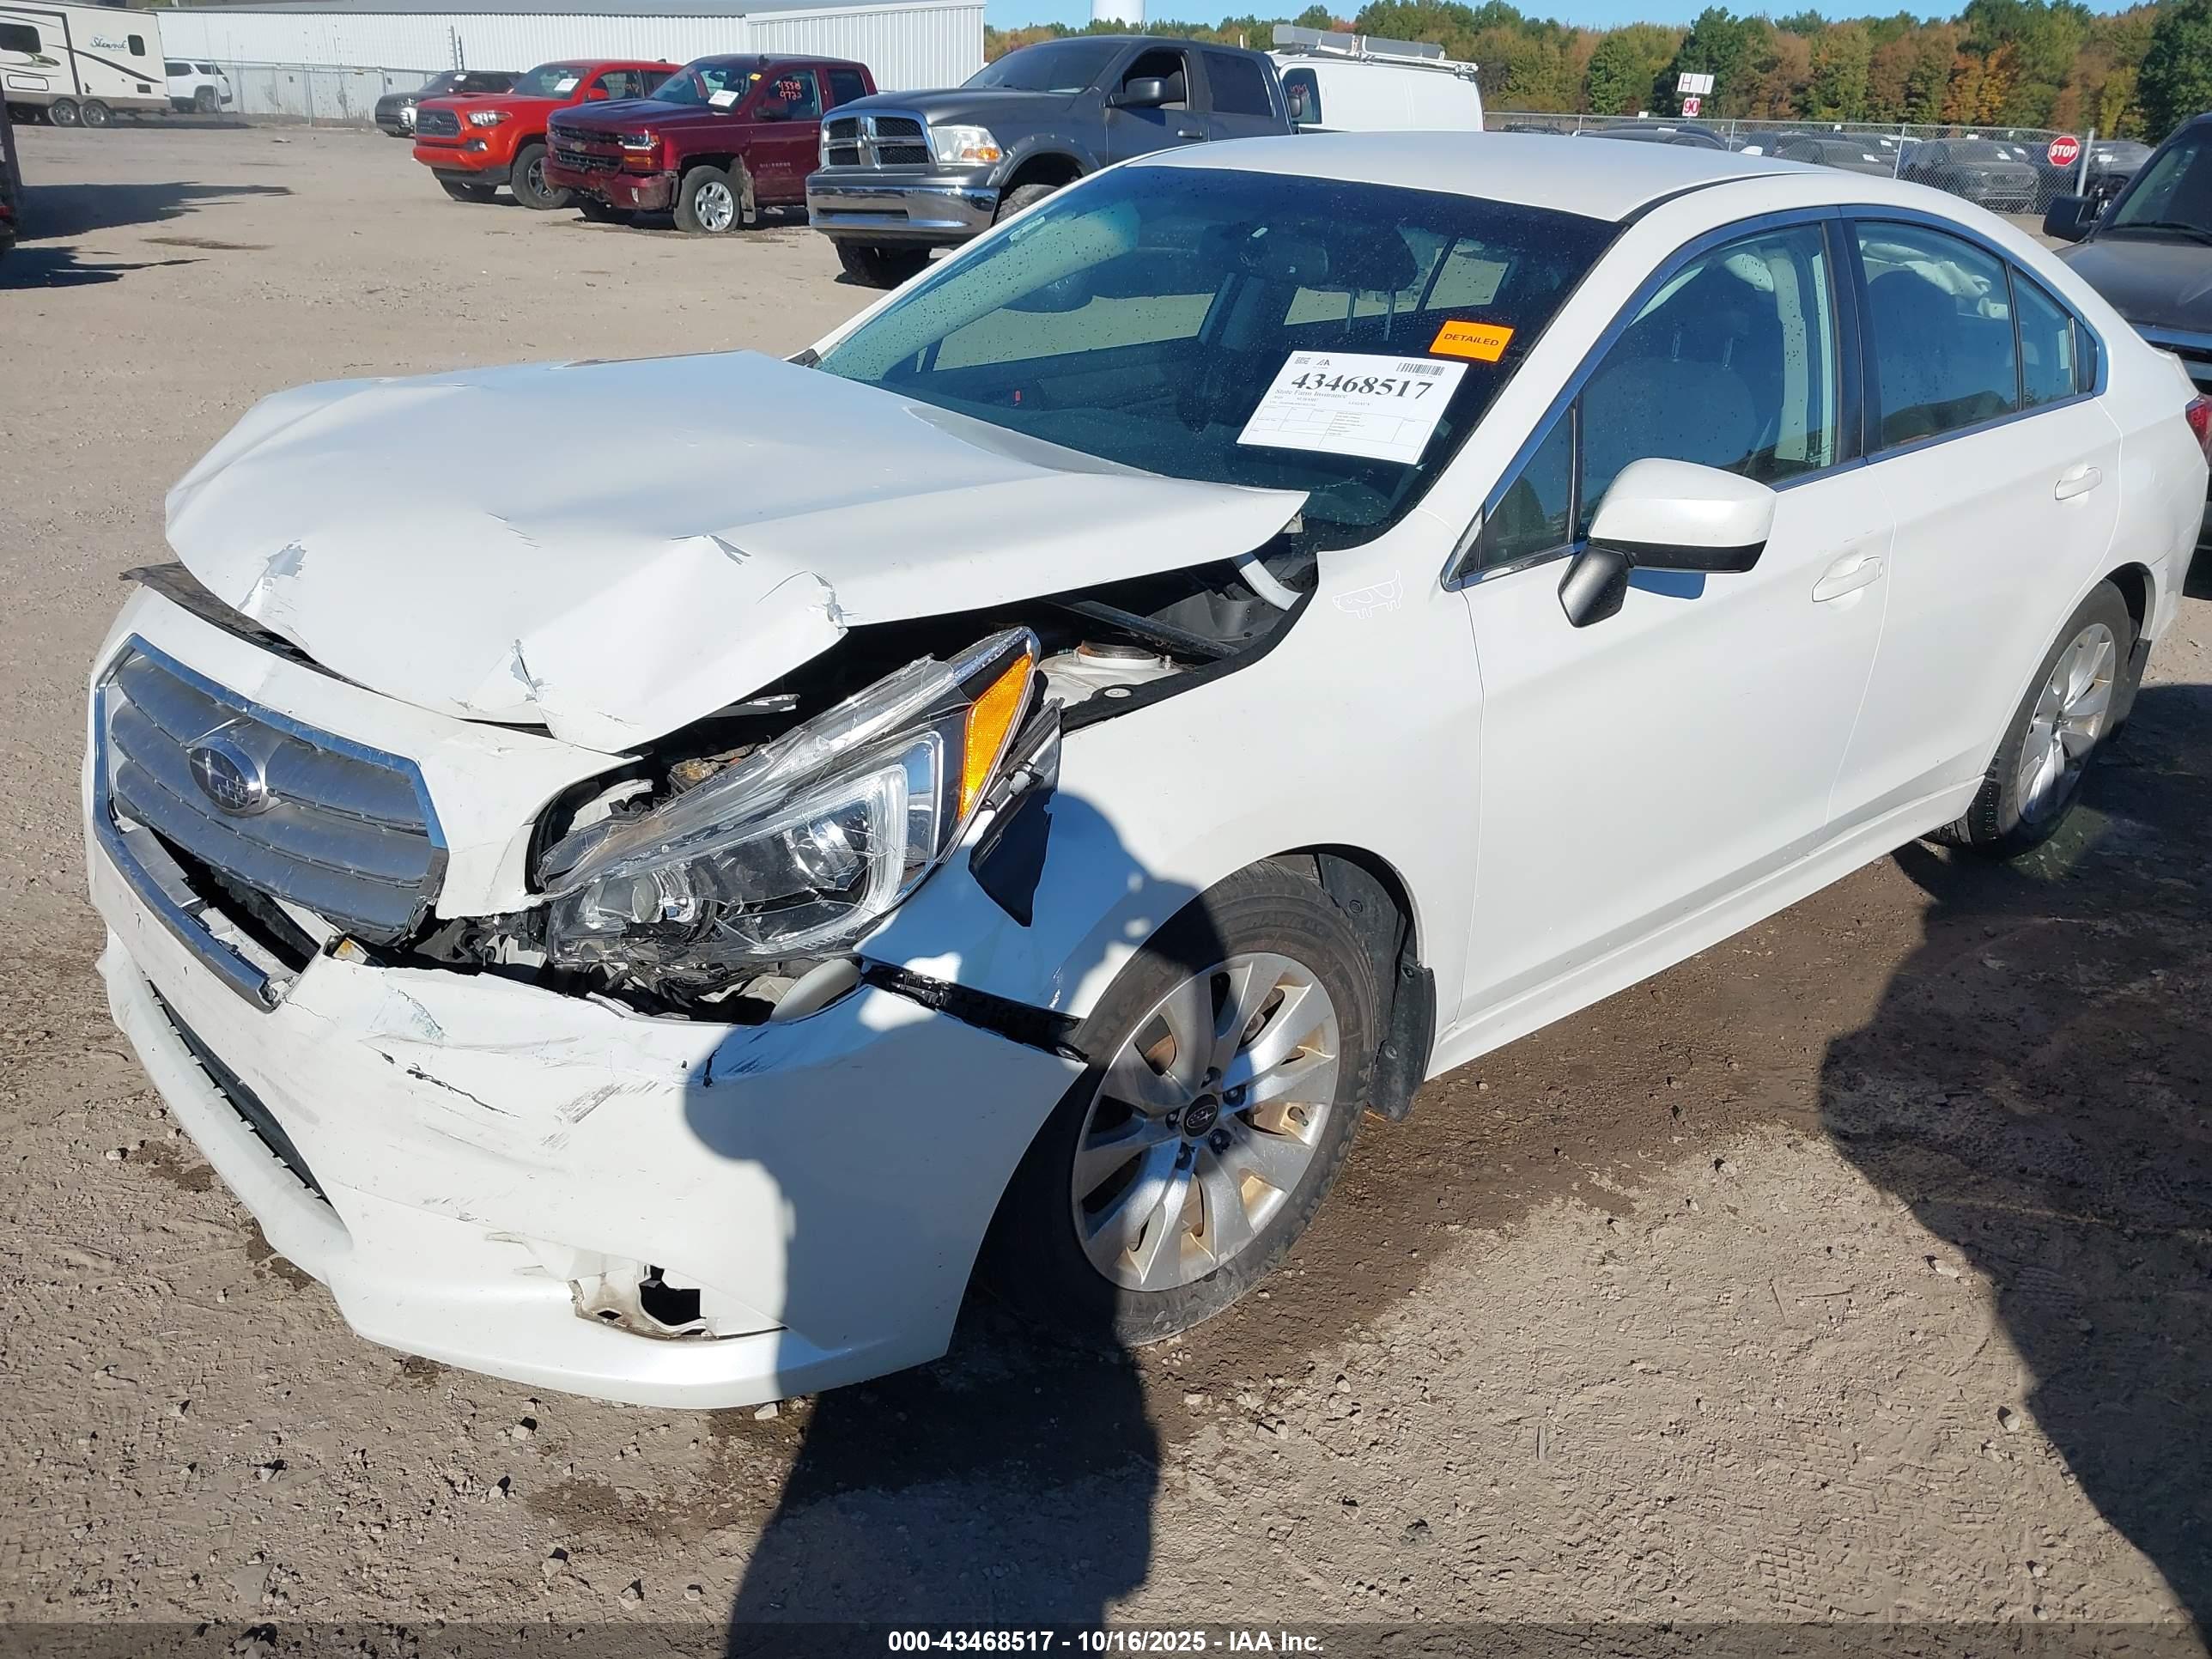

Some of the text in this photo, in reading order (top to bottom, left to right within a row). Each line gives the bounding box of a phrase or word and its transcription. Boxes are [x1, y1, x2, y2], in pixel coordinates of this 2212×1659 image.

[1683, 100, 1699, 113] 90
[2051, 144, 2078, 158] STOP
[1443, 333, 1499, 346] DETAILED
[1291, 373, 1434, 399] 43468517
